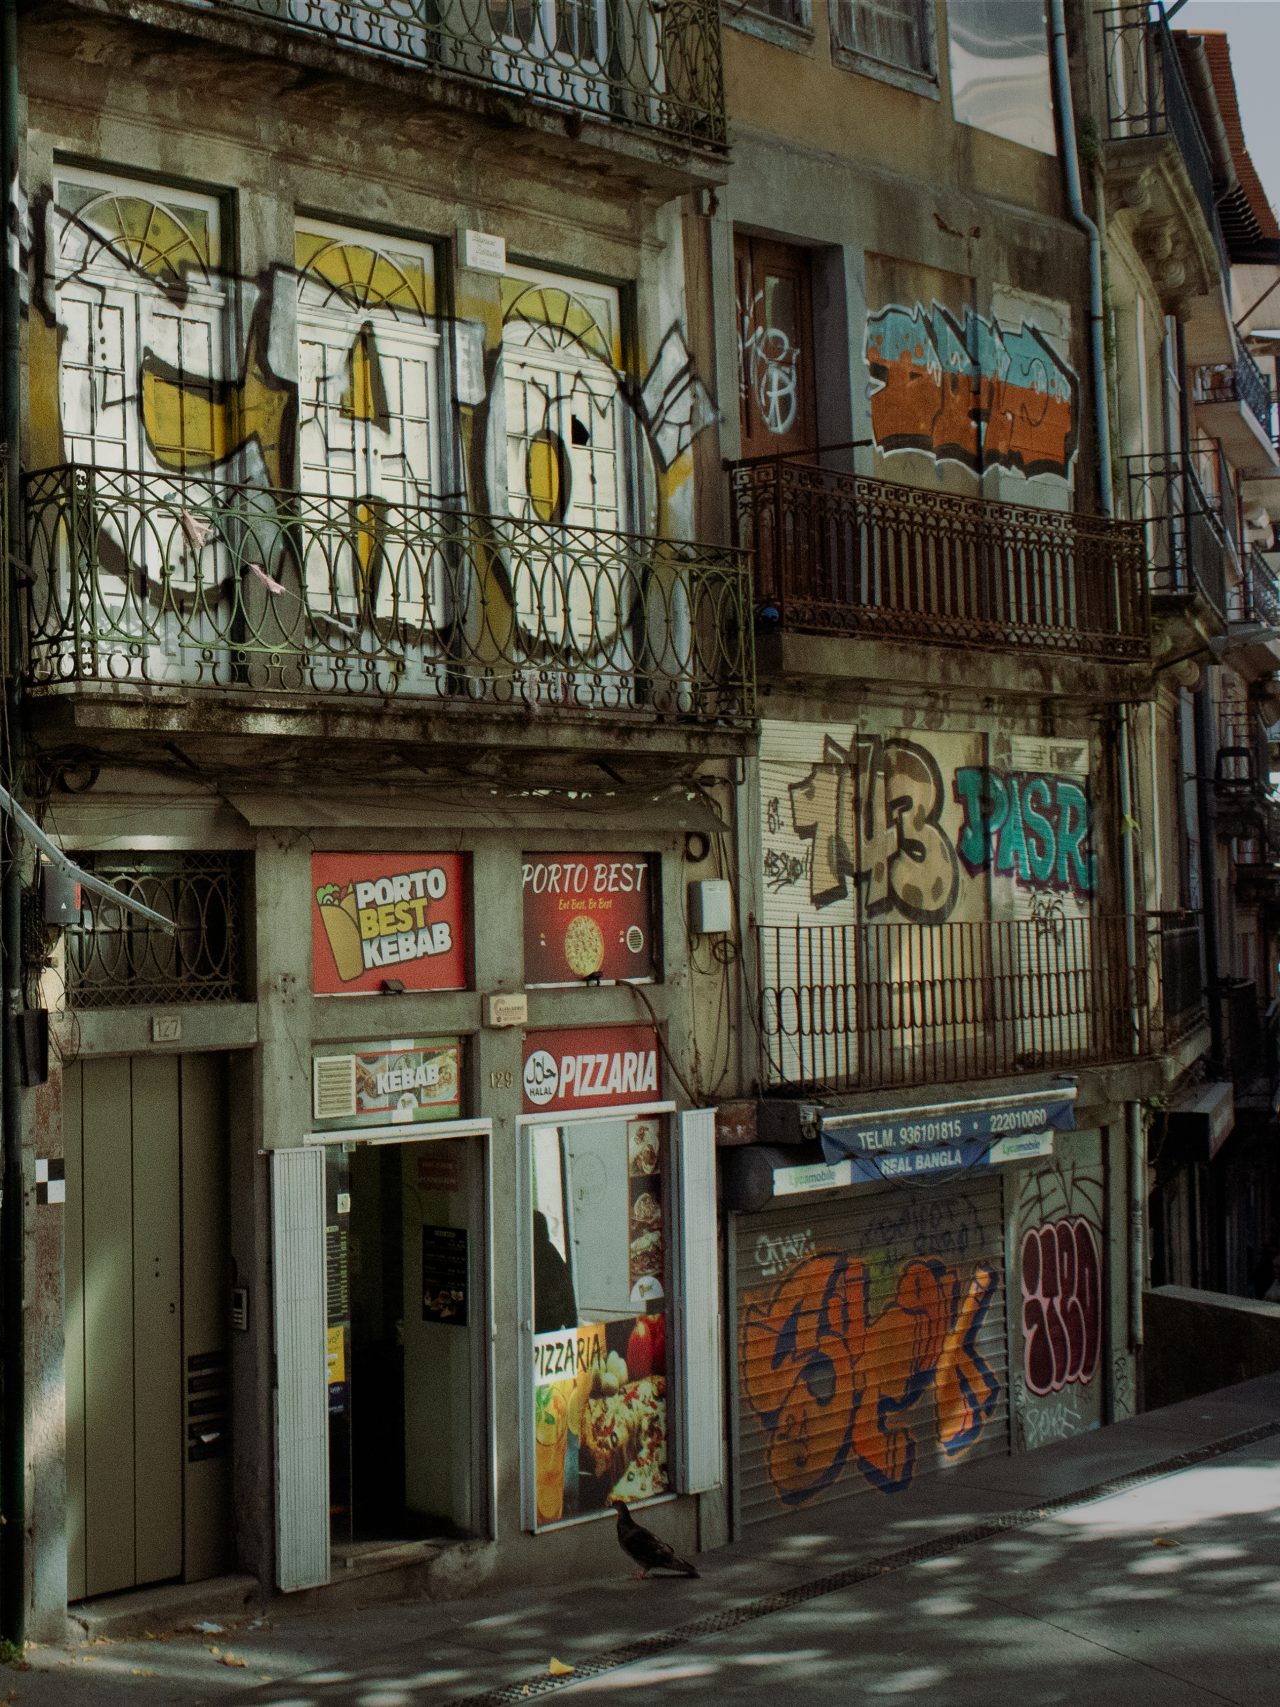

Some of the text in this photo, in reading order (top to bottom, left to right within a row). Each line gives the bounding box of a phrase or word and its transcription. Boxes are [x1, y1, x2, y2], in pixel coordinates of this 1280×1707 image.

[355, 868, 447, 909] PORTO
[521, 863, 648, 893] PORTO BEST
[358, 897, 429, 939] BEST
[362, 922, 452, 969] KEBAB
[376, 1063, 440, 1095] KEBAB
[489, 1071, 513, 1089] 129
[558, 1050, 658, 1098] PIZZARIA
[529, 1087, 553, 1097] HALAL
[857, 1130, 897, 1150] TELM.
[899, 1119, 962, 1145] 936101815
[915, 1149, 962, 1171] BANGLA
[534, 1333, 602, 1378] PIZZARIA
